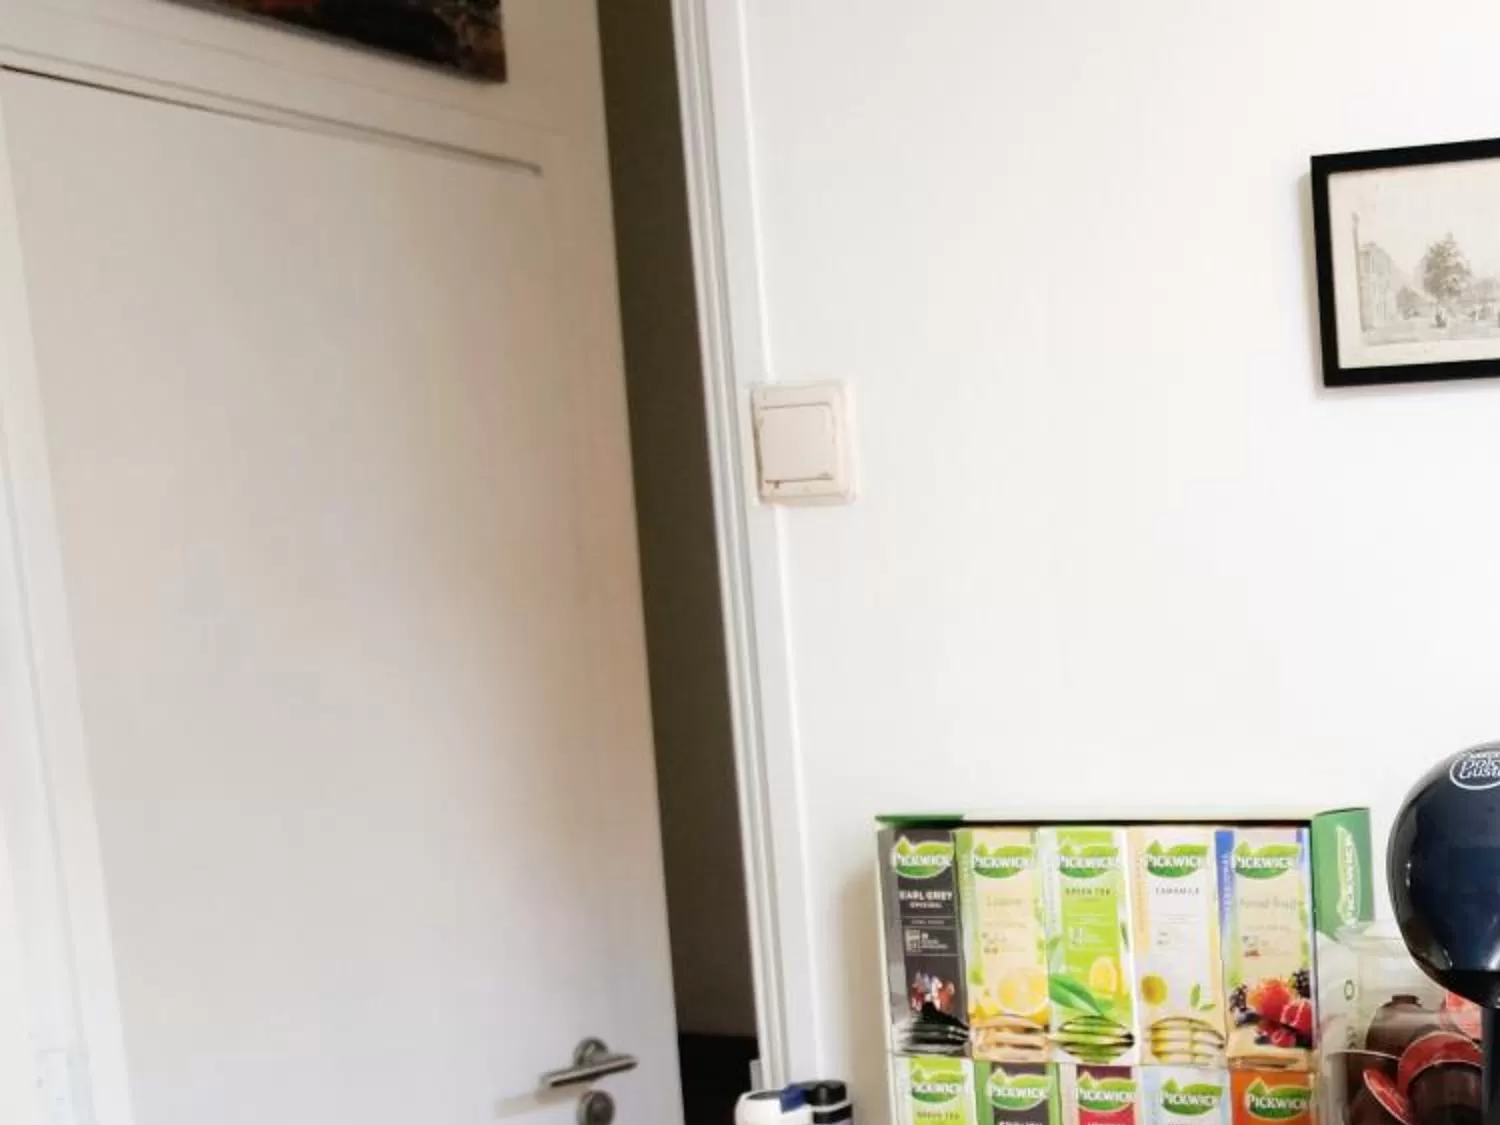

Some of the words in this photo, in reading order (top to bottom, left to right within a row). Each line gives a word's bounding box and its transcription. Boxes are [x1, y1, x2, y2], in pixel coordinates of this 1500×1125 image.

[892, 852, 953, 869] PICKWICK
[1058, 854, 1119, 870] PICKWICK
[1147, 854, 1207, 870] PICKWICK
[1235, 855, 1299, 870] PICKWICK
[900, 890, 924, 901] EARL
[926, 891, 953, 901] GREY
[987, 1086, 1048, 1100] PICKWICK
[1075, 1087, 1138, 1103] PICKWICK
[1162, 1093, 1224, 1107] PICKWICK
[1247, 1095, 1310, 1111] PICKWICK
